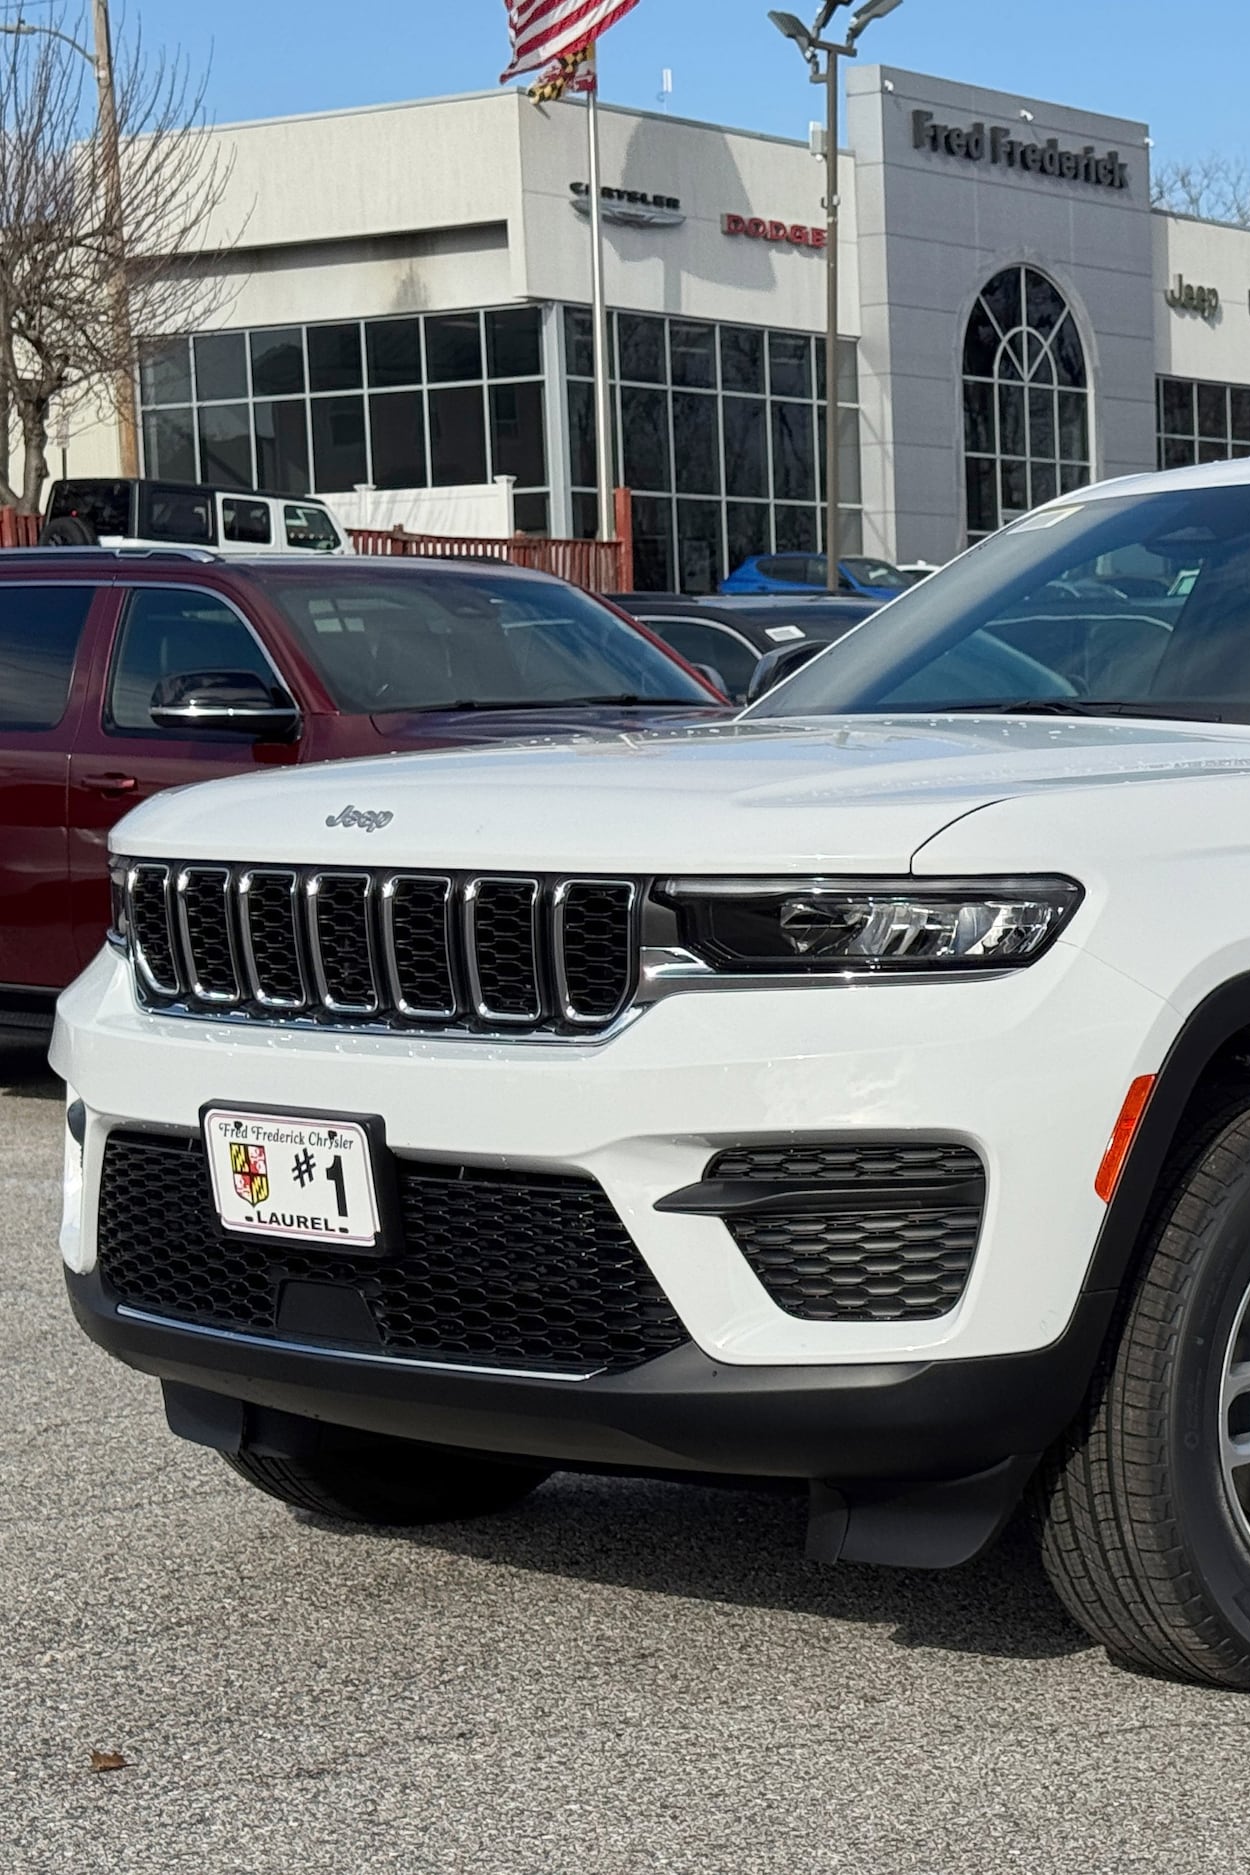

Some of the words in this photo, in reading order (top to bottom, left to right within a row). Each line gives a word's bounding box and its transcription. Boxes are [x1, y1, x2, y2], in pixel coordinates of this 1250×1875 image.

[911, 109, 985, 161] Fred
[990, 125, 1128, 188] Frederick
[721, 213, 828, 248] DODGE
[1164, 273, 1219, 319] Jeep
[325, 804, 394, 833] Jeep
[218, 1122, 248, 1140] Fred
[251, 1126, 306, 1145] Frederick
[308, 1131, 354, 1150] Chrysler
[256, 1210, 336, 1233] LAUREL
